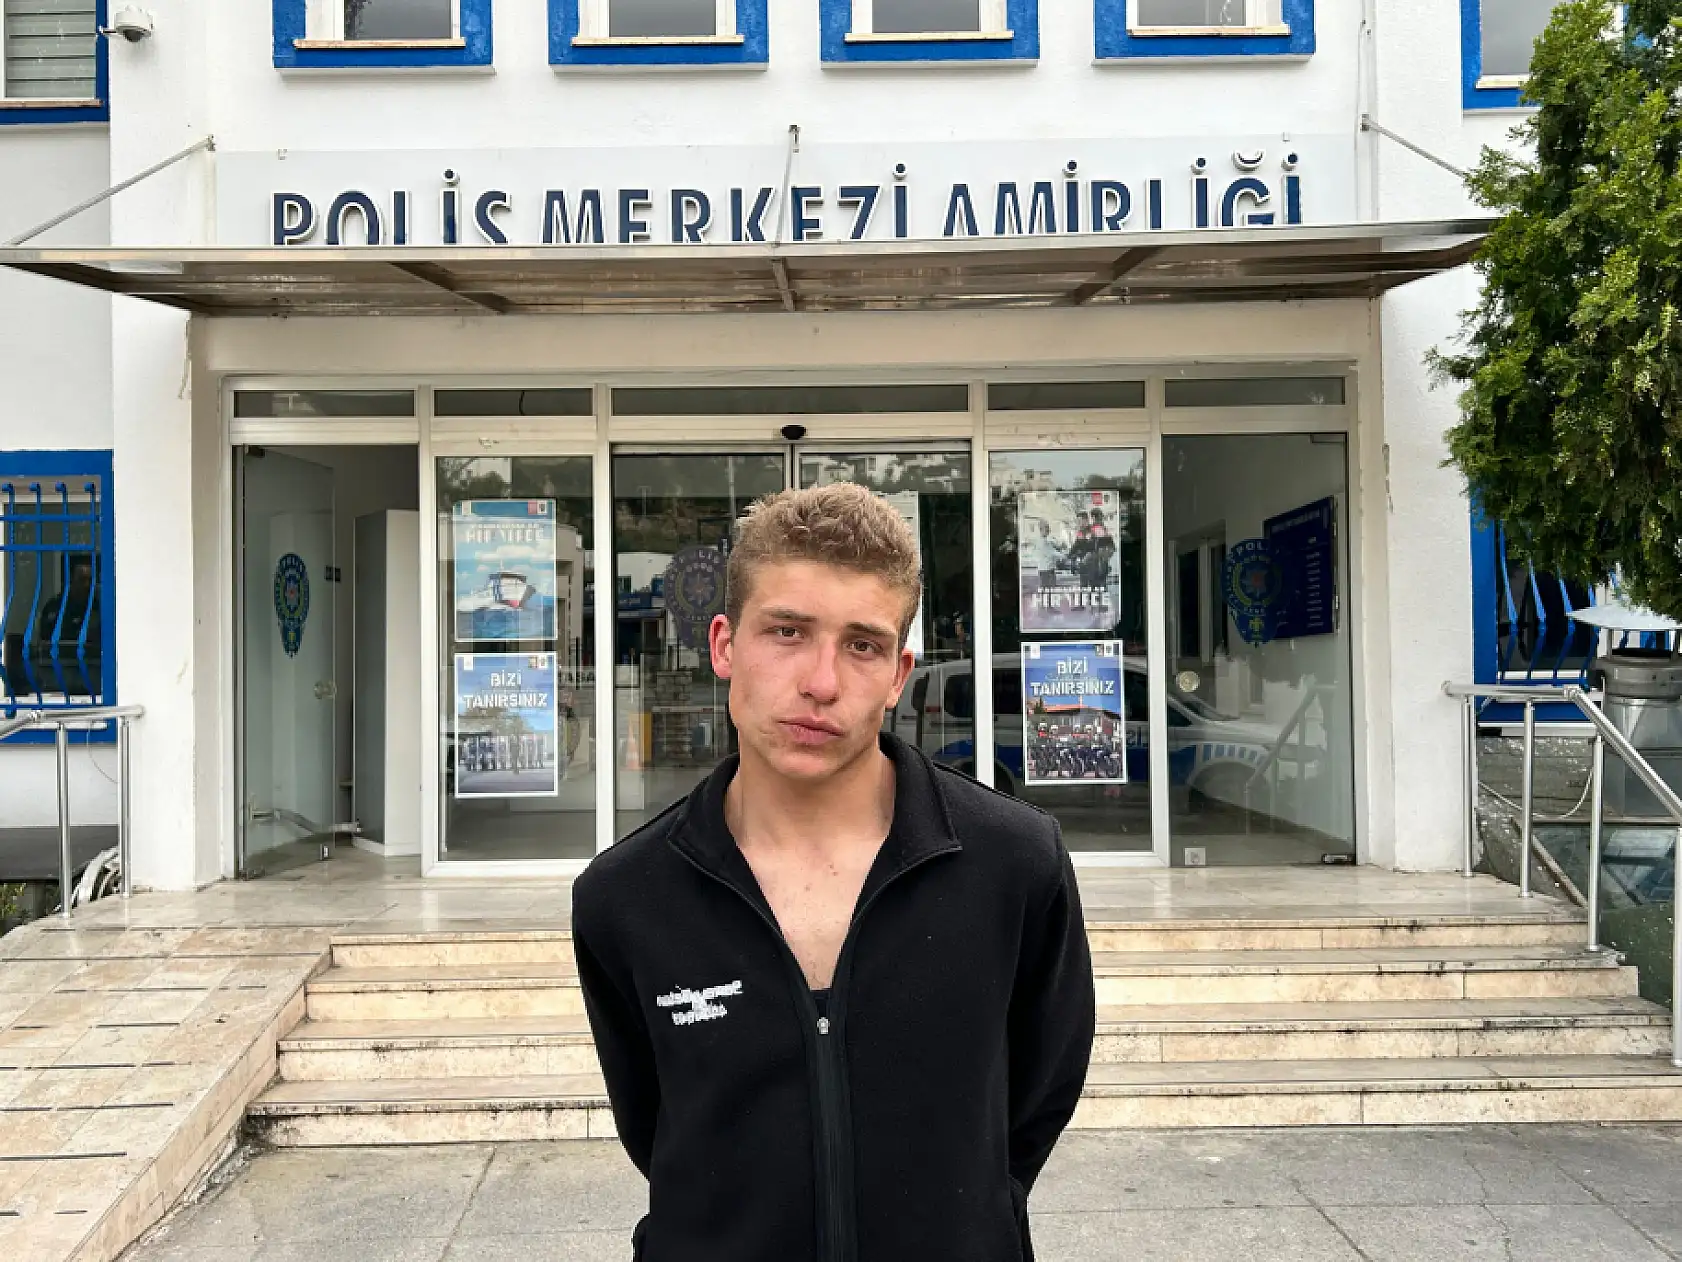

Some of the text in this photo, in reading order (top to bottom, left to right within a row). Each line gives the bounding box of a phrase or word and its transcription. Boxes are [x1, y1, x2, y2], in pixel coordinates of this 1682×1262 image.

[271, 150, 1305, 245] POLİS MERKEZİ AMİRLİĞİ
[490, 669, 522, 687] BİZİ
